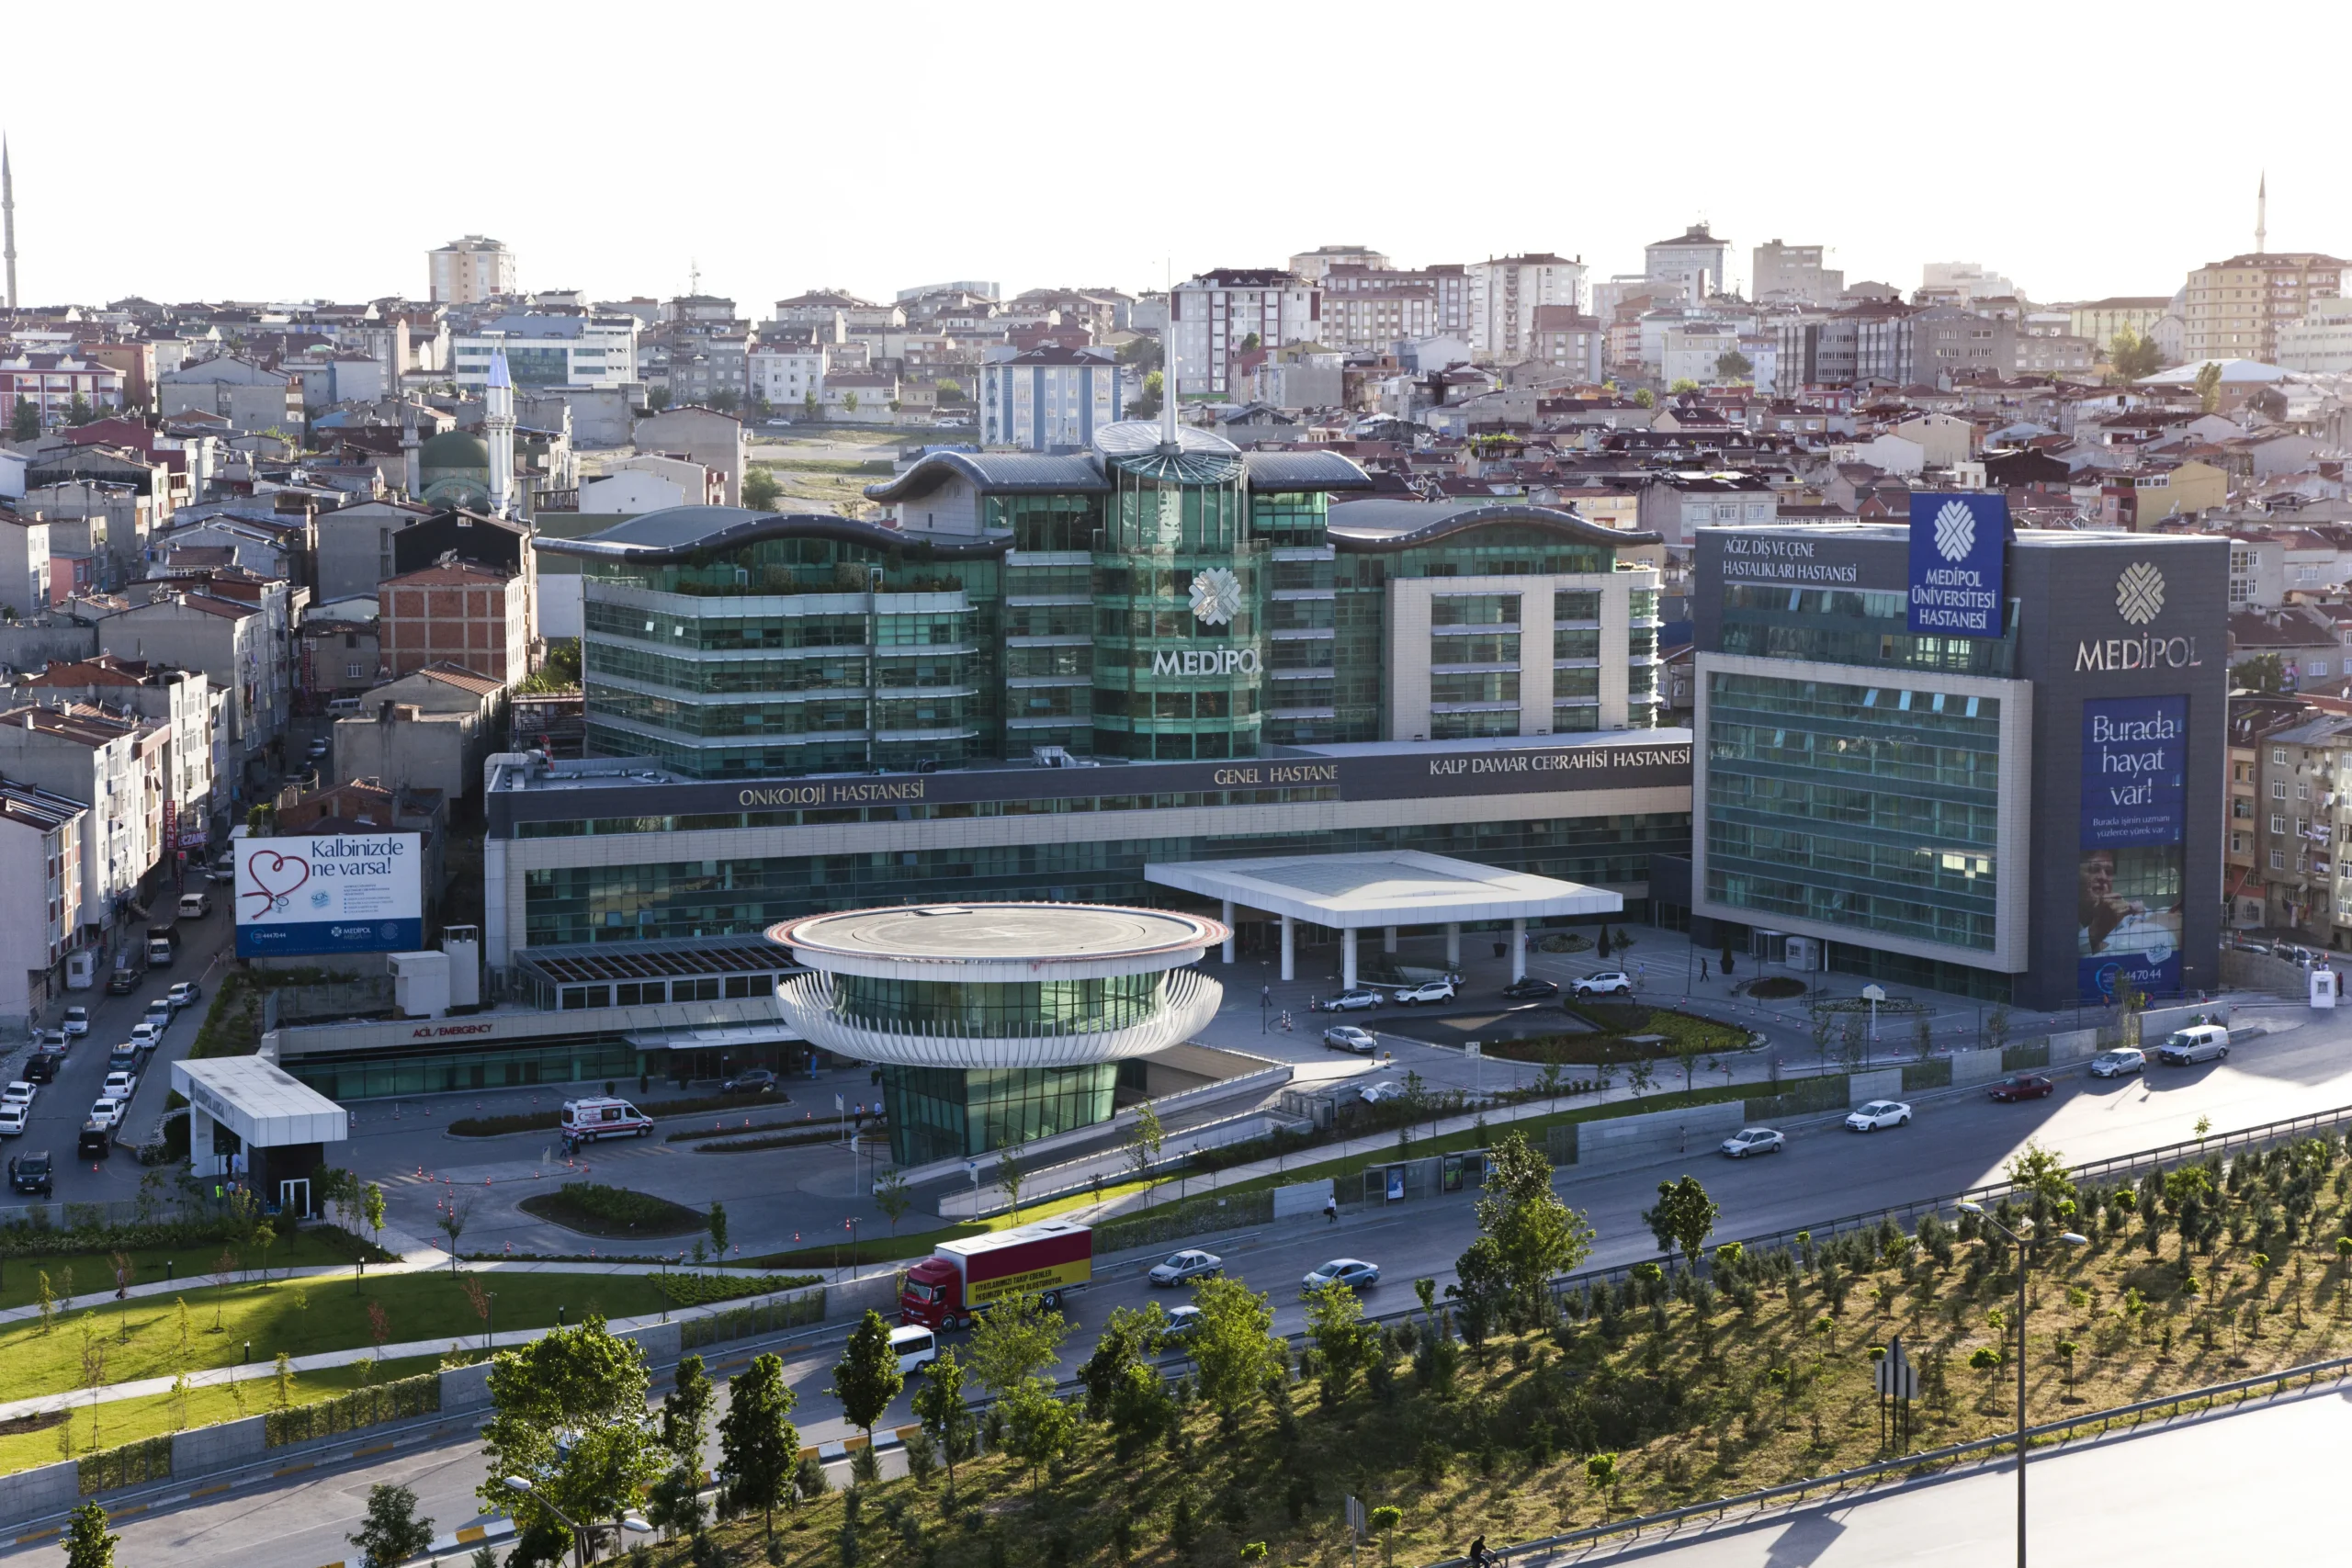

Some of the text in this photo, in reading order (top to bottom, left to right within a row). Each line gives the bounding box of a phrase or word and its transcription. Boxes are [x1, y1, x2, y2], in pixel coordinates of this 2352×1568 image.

[1724, 536, 1815, 560] AĞIZ, DİŞ VE ÇENE
[1723, 560, 1857, 582] HASTALIKLARI HASTANESİ
[1925, 566, 1982, 588] MEDİPOL
[1912, 584, 1996, 609] ÜNİVERSİTESİ
[1919, 609, 1987, 629] HASTANESİ
[1151, 644, 1263, 676] MEDİPOL
[2074, 631, 2202, 672] MEDİPOL
[2093, 710, 2175, 743] Burada
[1430, 746, 1690, 775] KALP DAMAR CERRAHİSİ HASTANESİ
[2102, 745, 2165, 779] hayat
[1214, 764, 1339, 784] GENEL HASTANE
[739, 779, 924, 807] ONKOLOJİ HASTANESİ
[2109, 777, 2153, 806] var!
[166, 801, 175, 849] ECZANE
[2093, 815, 2170, 828] Burada işinin uzmanı
[2097, 826, 2166, 839] yüzlerce yürek var.
[311, 837, 403, 858] Kalbinizde
[312, 857, 391, 877] ne varsa!
[1029, 1269, 1052, 1281] EDENLER
